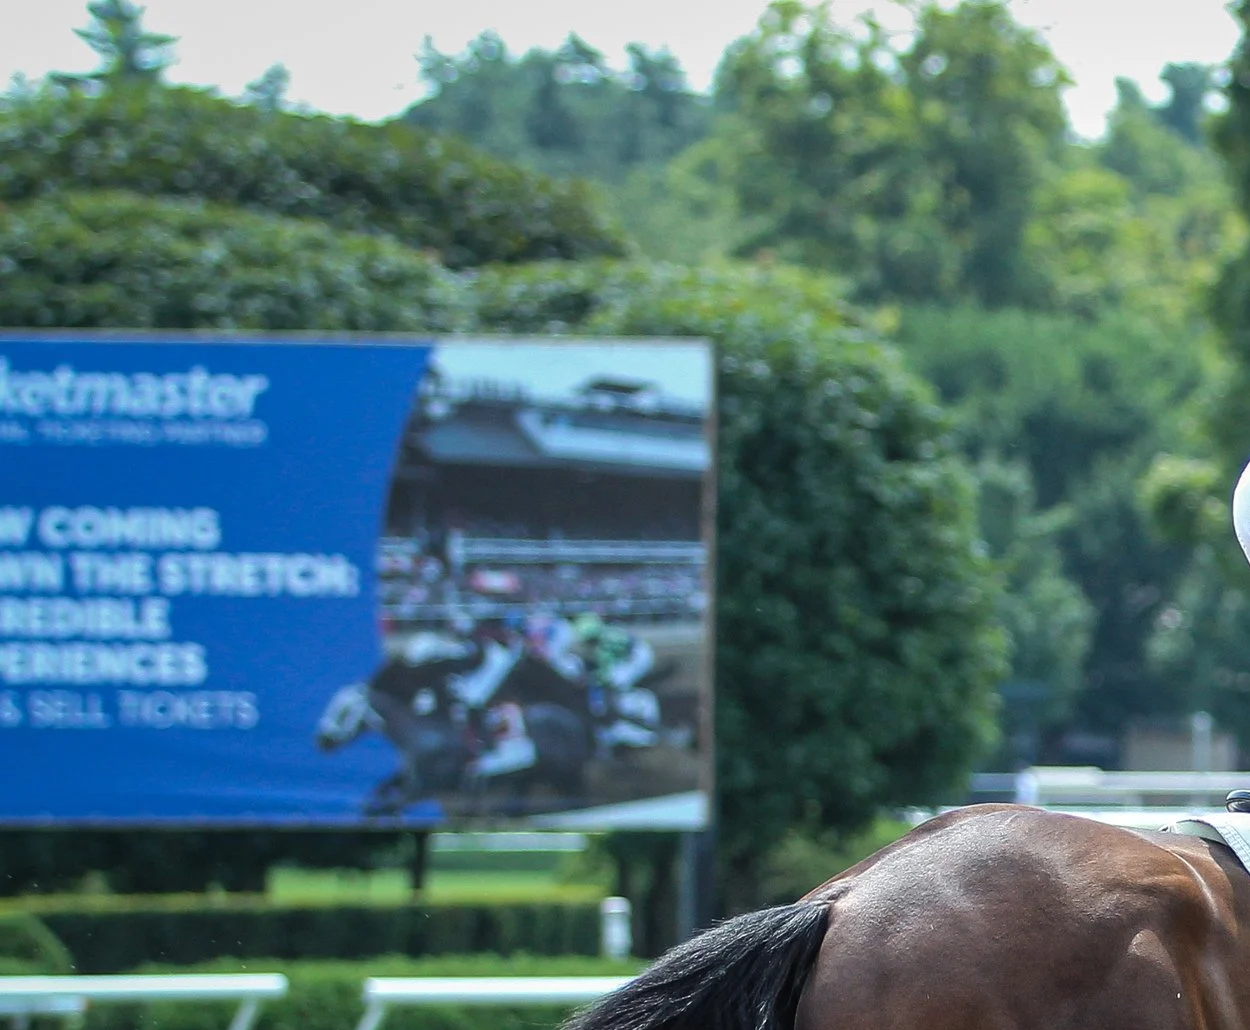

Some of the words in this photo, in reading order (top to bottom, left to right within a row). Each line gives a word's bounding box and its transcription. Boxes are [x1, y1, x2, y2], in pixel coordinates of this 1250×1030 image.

[38, 505, 221, 549] COMING
[70, 552, 153, 595] THE
[0, 641, 208, 686] ERIENCES
[28, 689, 111, 728] SELL
